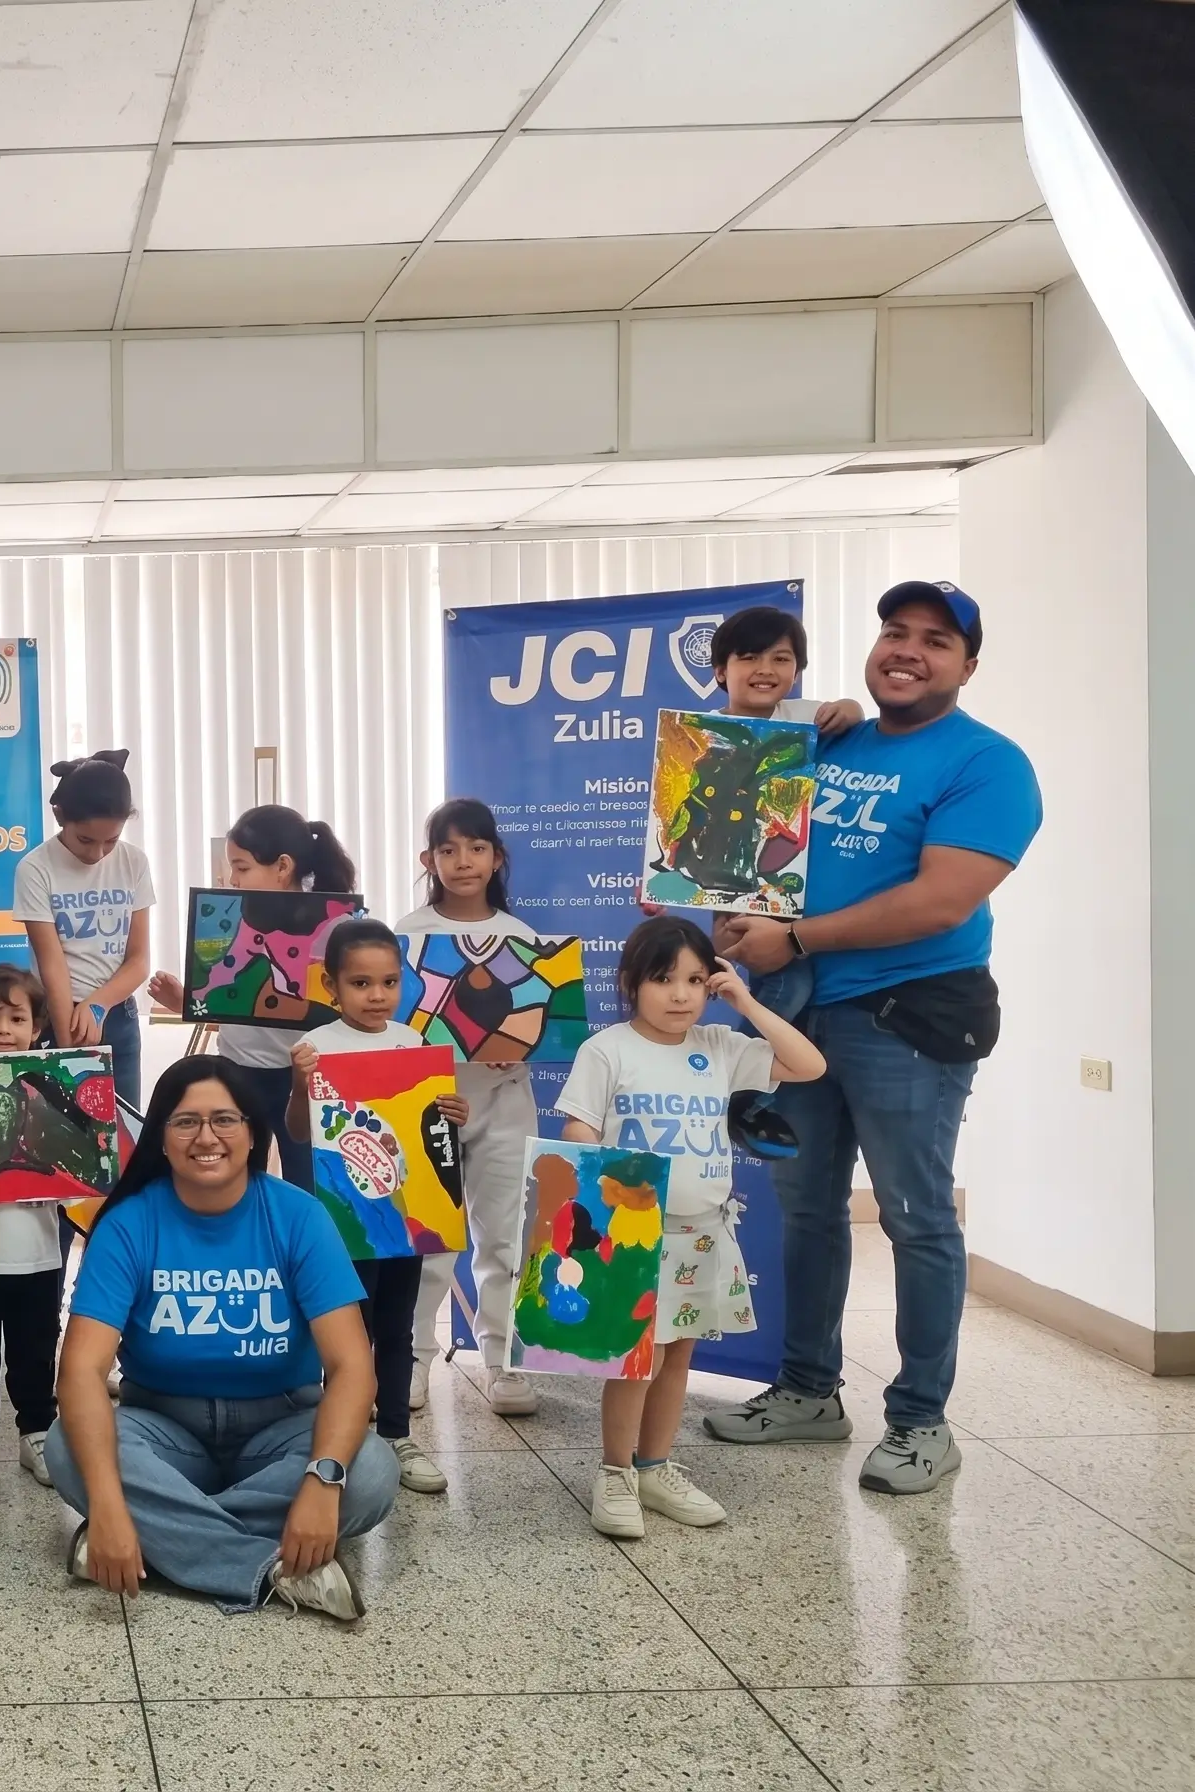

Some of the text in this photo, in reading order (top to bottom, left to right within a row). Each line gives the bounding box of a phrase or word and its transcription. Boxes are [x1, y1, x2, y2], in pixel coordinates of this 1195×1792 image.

[489, 628, 654, 706] JCI
[554, 710, 644, 742] Zulia
[585, 777, 649, 795] Misión
[152, 1268, 283, 1292] BRIGADA
